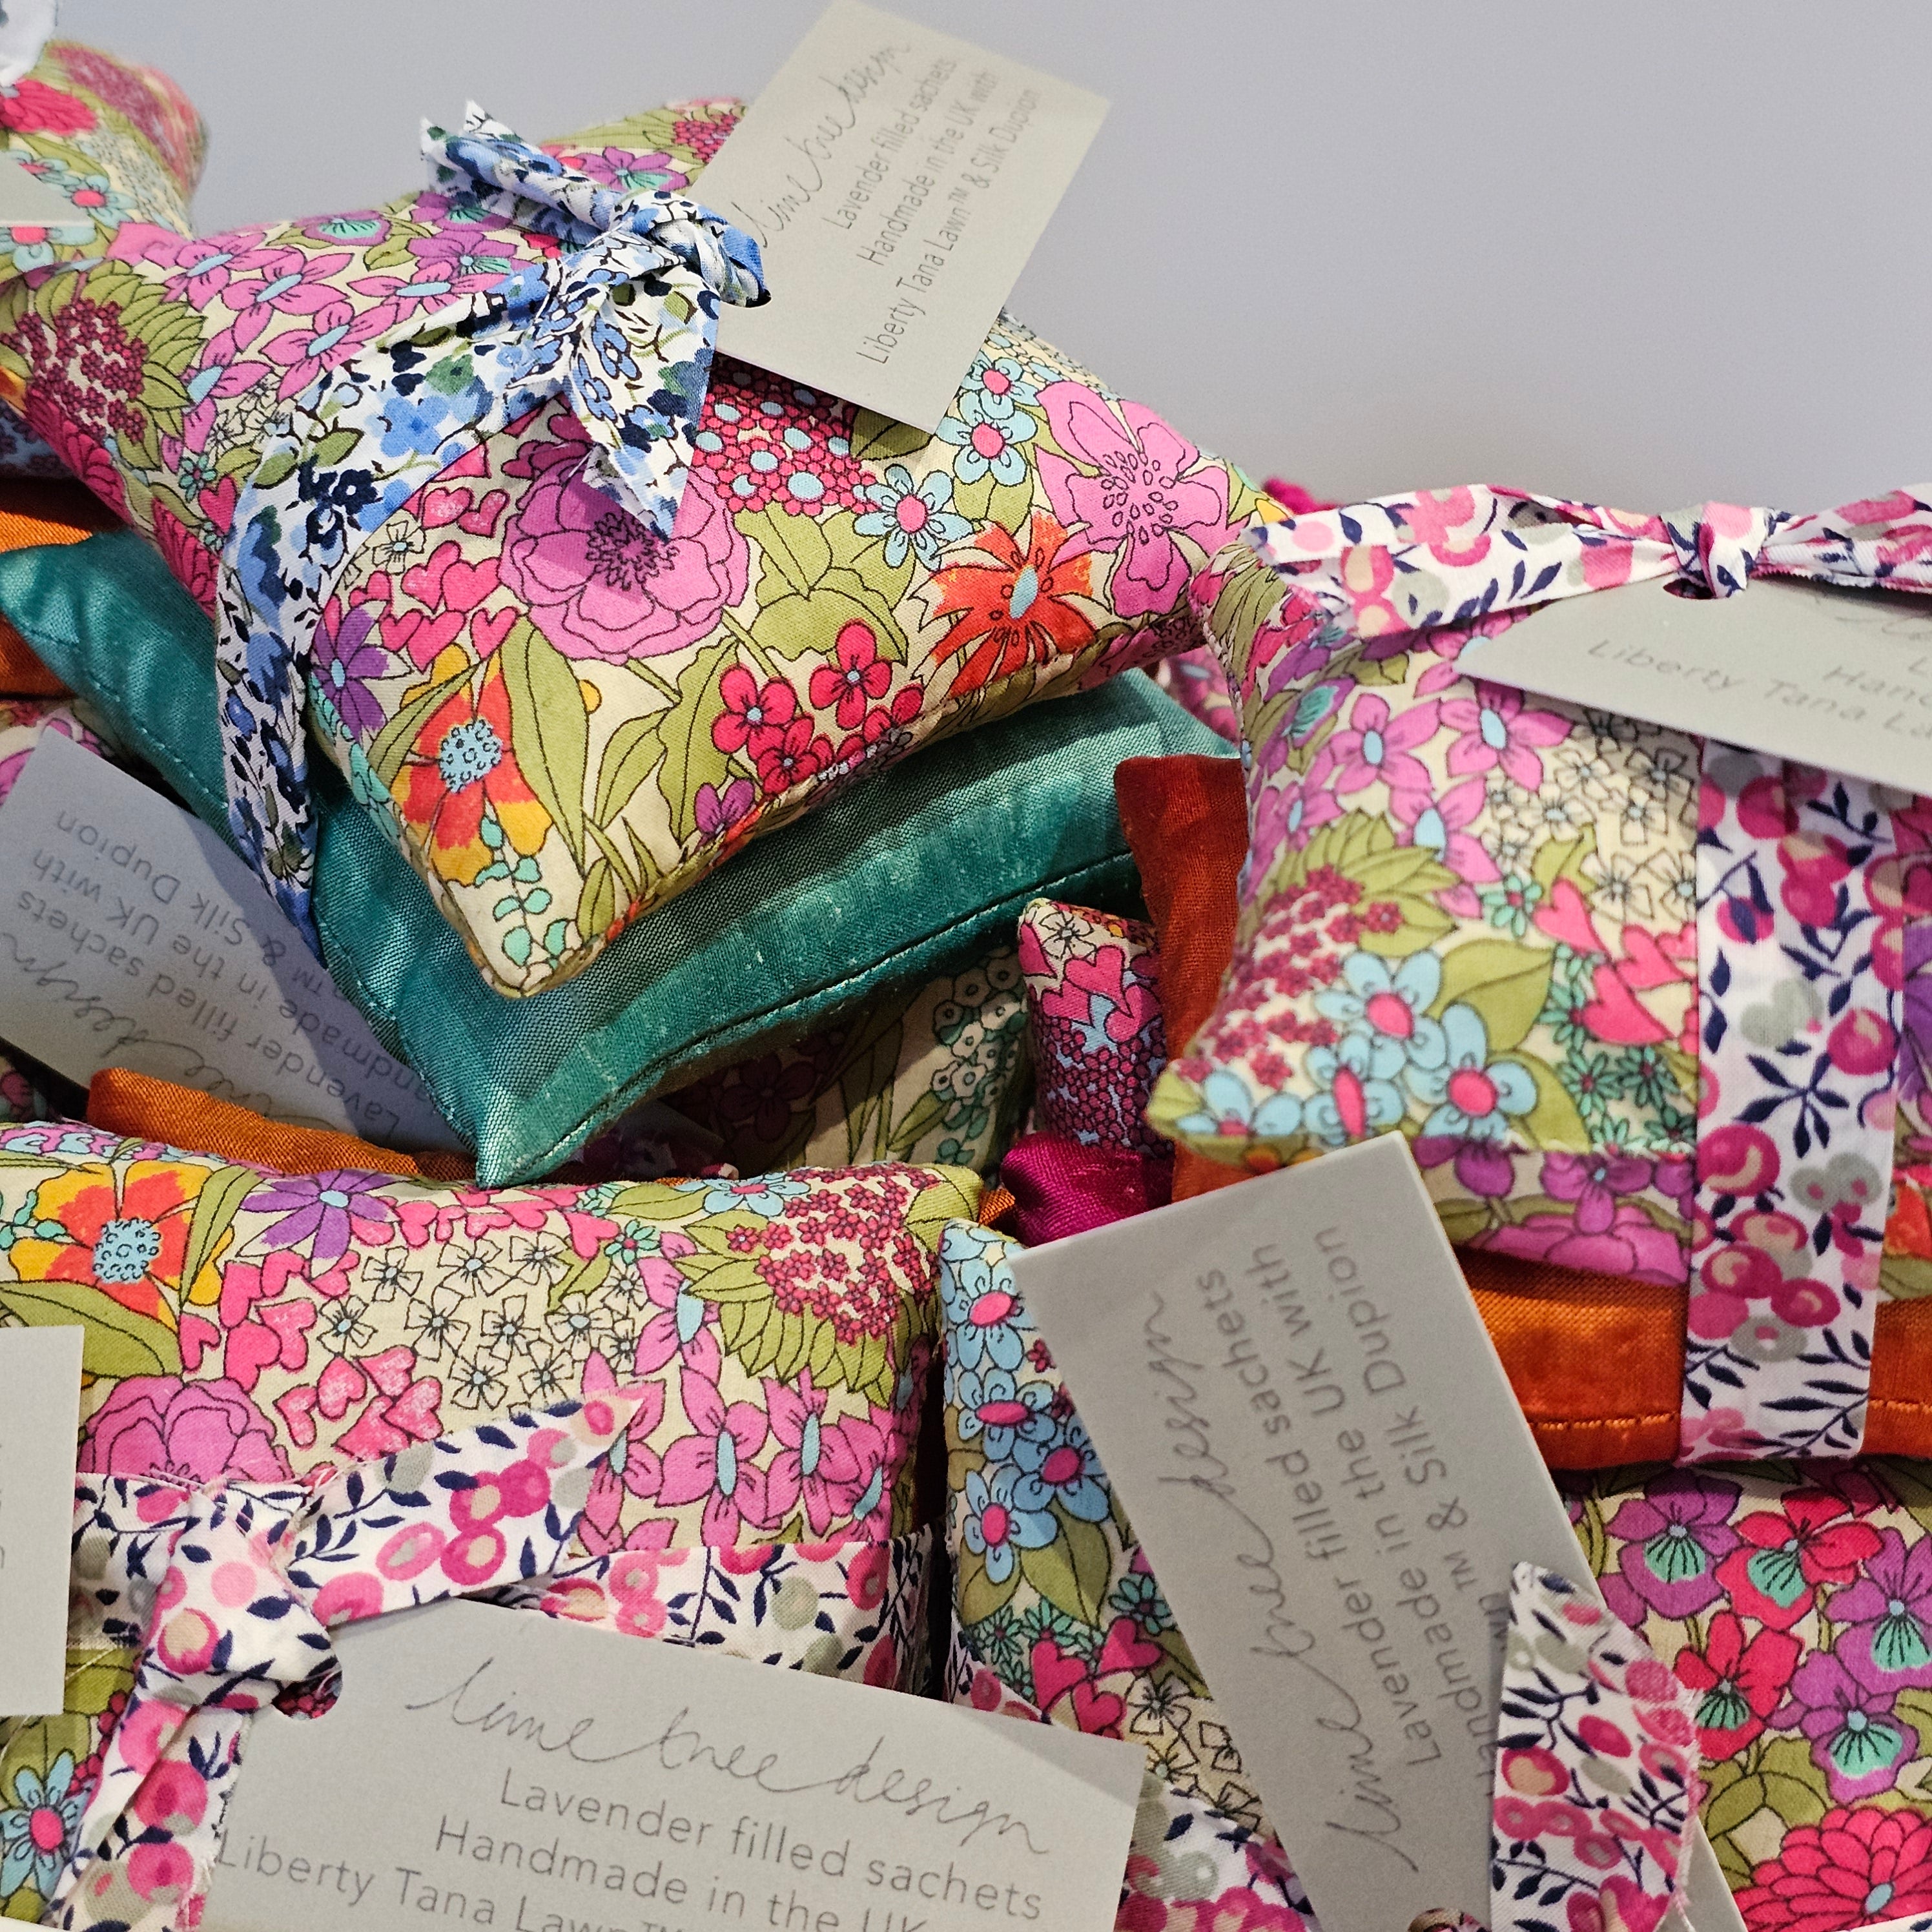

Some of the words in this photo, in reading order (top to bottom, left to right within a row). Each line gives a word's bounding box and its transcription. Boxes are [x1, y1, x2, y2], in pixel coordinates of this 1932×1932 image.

[821, 151, 890, 230] Lavender
[871, 107, 920, 154] filled
[909, 57, 958, 112] sachets
[929, 127, 965, 155] the
[945, 99, 980, 128] UK
[915, 155, 948, 175] in
[960, 172, 991, 190] &
[970, 143, 1010, 174] Silk
[731, 173, 821, 249] lime
[856, 172, 936, 267] Handmade
[895, 254, 945, 293] Tana
[856, 298, 927, 364] Liberty
[1587, 639, 1741, 692] Liberty
[1763, 677, 1867, 723] Tana
[33, 848, 102, 904] with
[56, 810, 181, 905] Dupion
[16, 890, 144, 978] sachets
[105, 896, 161, 947] UK
[172, 935, 225, 981] the
[190, 892, 251, 946] Silk
[259, 936, 287, 967] &
[3, 932, 150, 1059] design
[147, 972, 239, 1042] filled
[238, 972, 268, 1009] in
[246, 1033, 400, 1138] Lavender
[1245, 1242, 1312, 1339] with
[1313, 1226, 1407, 1396] Dupion
[1197, 1268, 1291, 1435] sachets
[1290, 1347, 1346, 1417] UK
[1144, 1290, 1236, 1497] design
[1337, 1428, 1386, 1499] the
[1384, 1405, 1448, 1485] Silk
[1264, 1449, 1348, 1560] filled
[1375, 1513, 1413, 1555] in
[1425, 1496, 1469, 1532] &
[1236, 1540, 1317, 1658] tree
[1333, 1577, 1443, 1767] Lavender
[405, 1657, 601, 1763] lime
[657, 1707, 791, 1793] tree
[835, 1735, 1049, 1855] design
[1317, 1712, 1420, 1873] lime
[217, 1828, 376, 1907] Liberty
[395, 1866, 496, 1926] Tana
[435, 1814, 688, 1905] Handmade
[708, 1876, 745, 1918] in
[767, 1889, 840, 1932] the
[500, 1767, 714, 1847] Lavender
[732, 1815, 850, 1877] filled
[867, 1862, 1042, 1920] sachets
